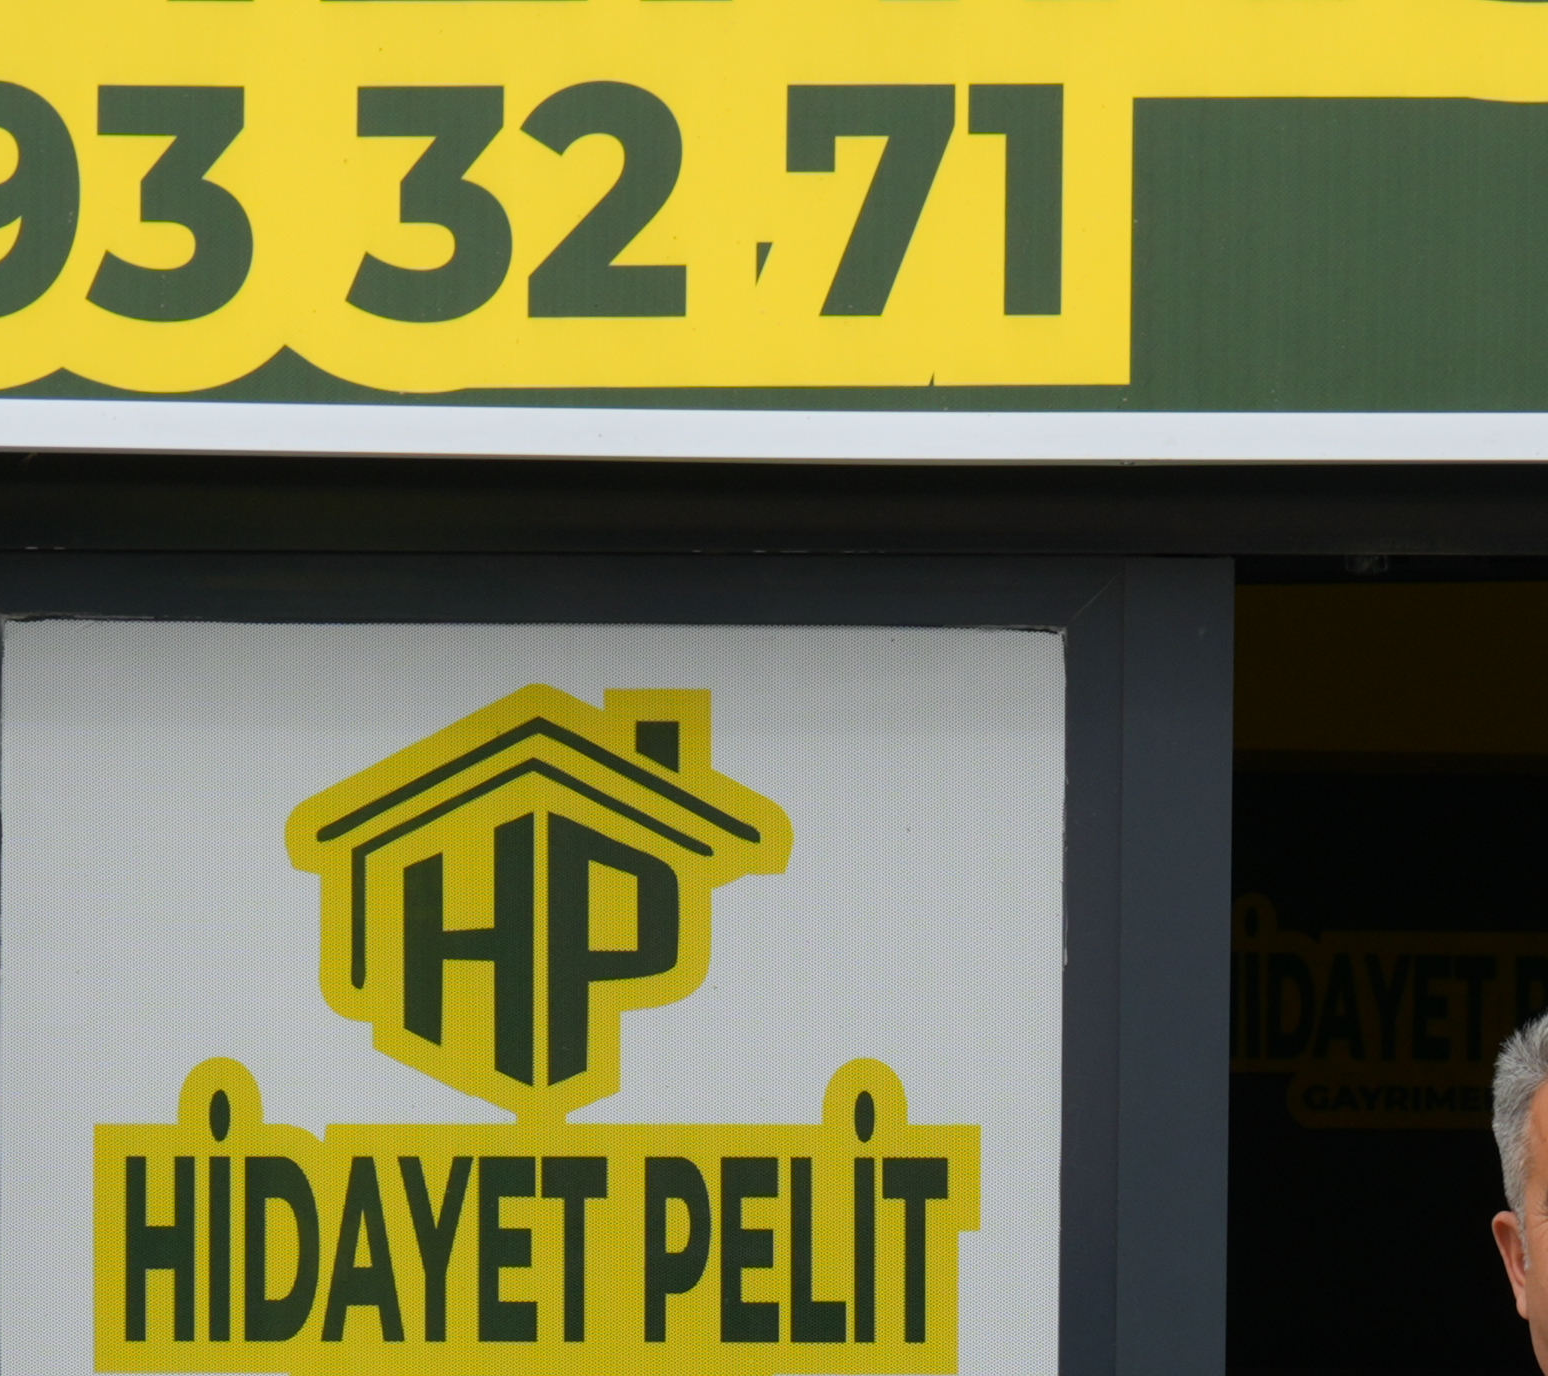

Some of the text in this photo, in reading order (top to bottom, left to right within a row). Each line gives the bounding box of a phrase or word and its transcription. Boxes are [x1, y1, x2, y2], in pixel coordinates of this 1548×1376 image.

[347, 81, 686, 323] 32
[787, 84, 1063, 316] 71
[402, 811, 680, 1087] HP
[1232, 907, 1496, 1059] İDAYET
[126, 1091, 948, 1343] HİDAYET PELİT
